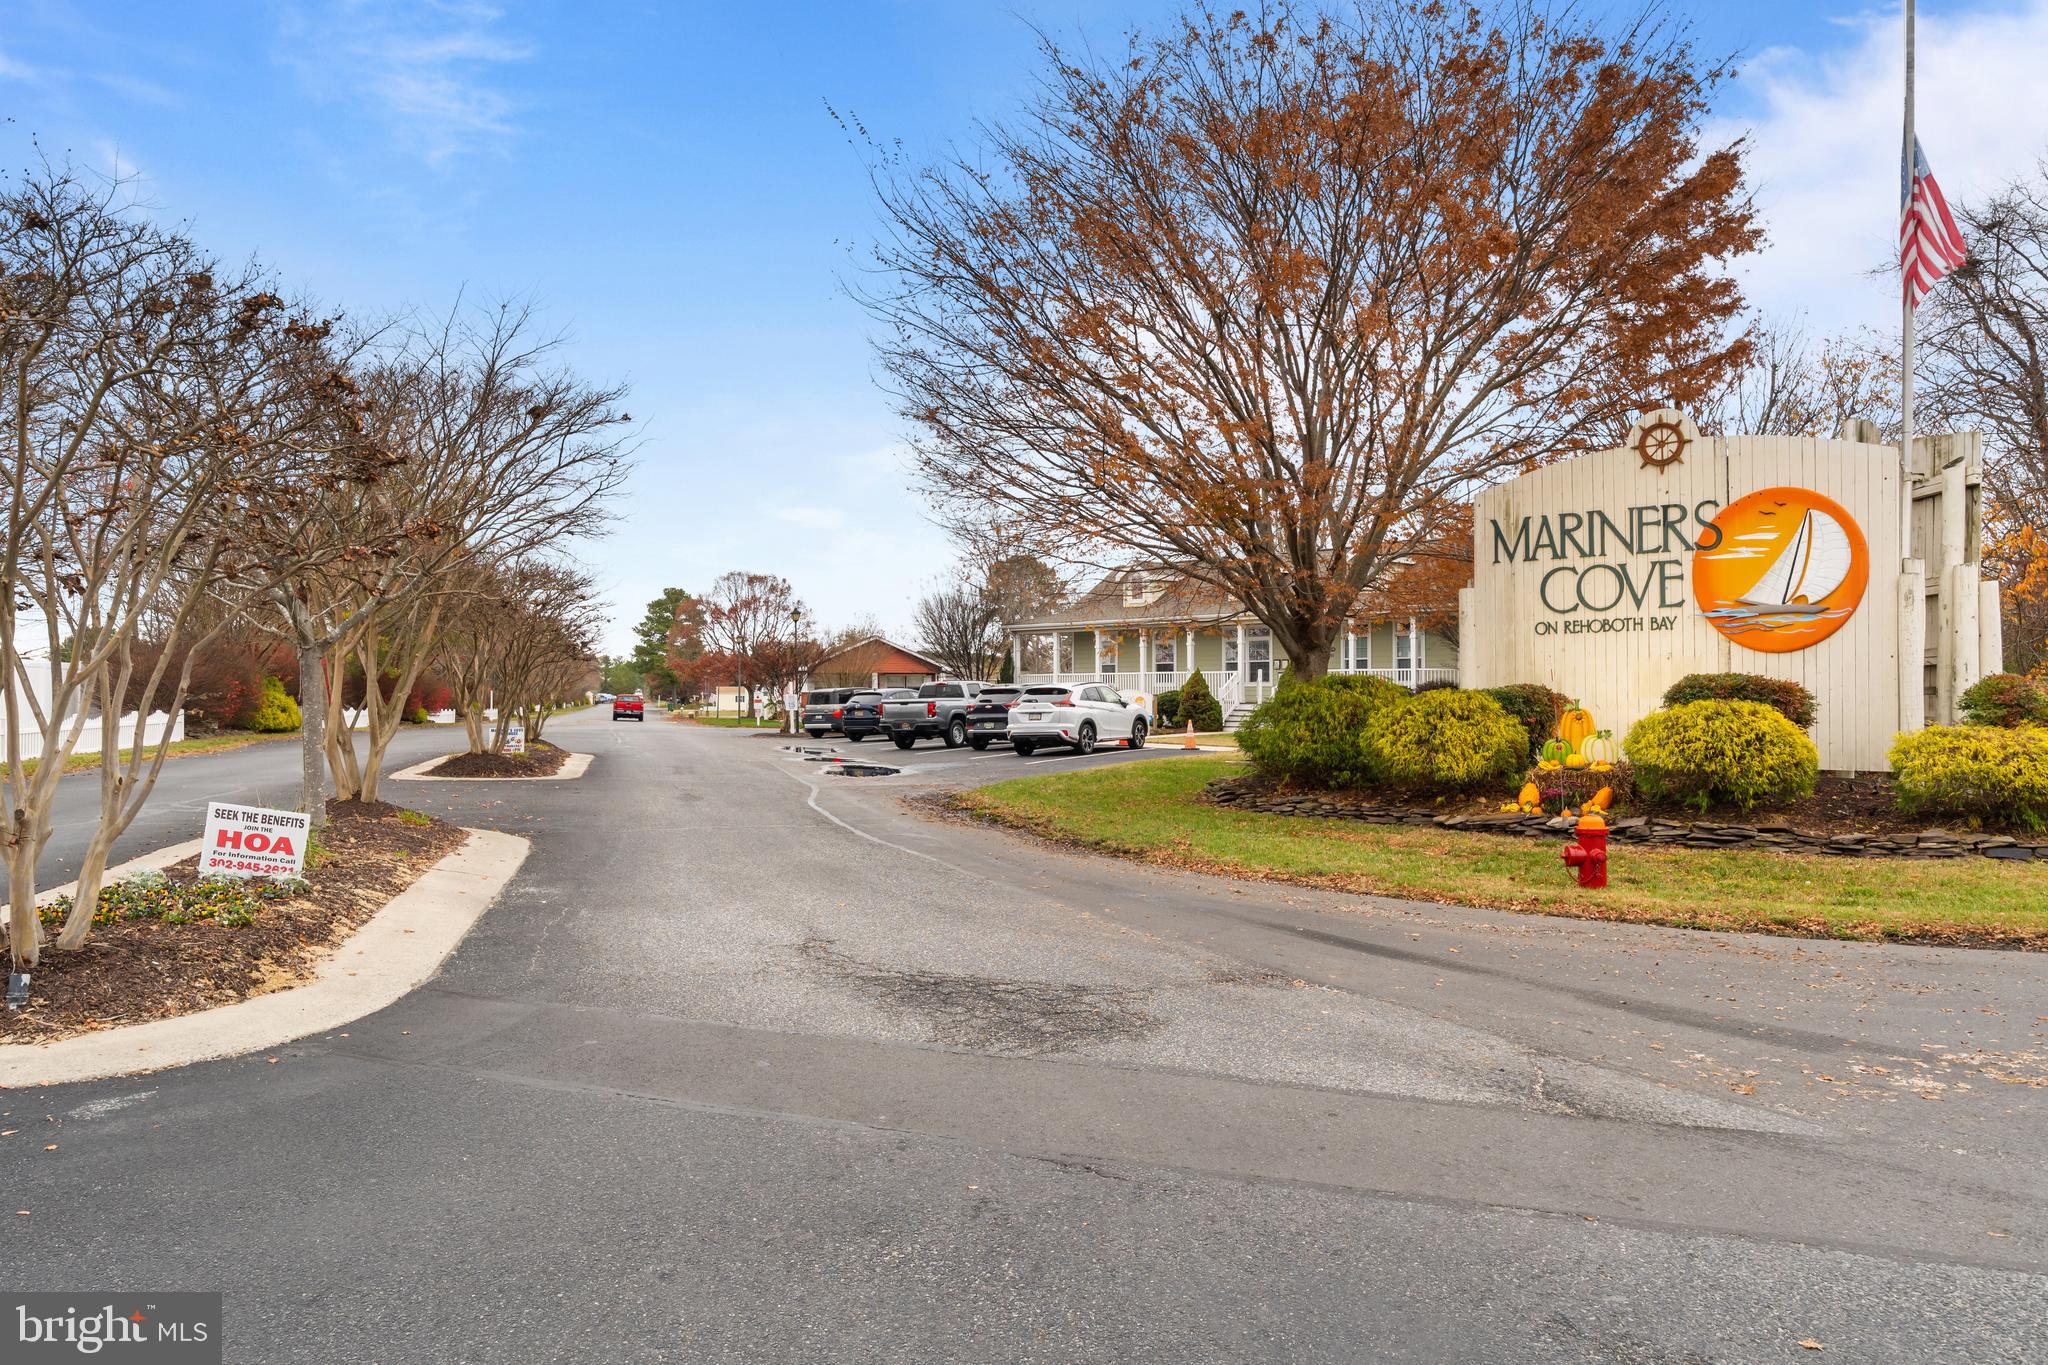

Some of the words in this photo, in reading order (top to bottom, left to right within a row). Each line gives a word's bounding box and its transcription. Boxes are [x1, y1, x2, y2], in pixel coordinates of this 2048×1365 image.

[1490, 500, 1723, 564] MARINERS
[1540, 559, 1685, 614] COVE
[1535, 621, 1558, 636] ON
[1564, 616, 1643, 635] REHOBOTH
[1650, 615, 1677, 631] BAY
[214, 808, 239, 821] SEEK
[241, 811, 259, 823] THE
[261, 814, 305, 829] BENEFITS
[216, 829, 295, 856] HOA
[228, 851, 278, 863] Information
[280, 857, 296, 865] Call
